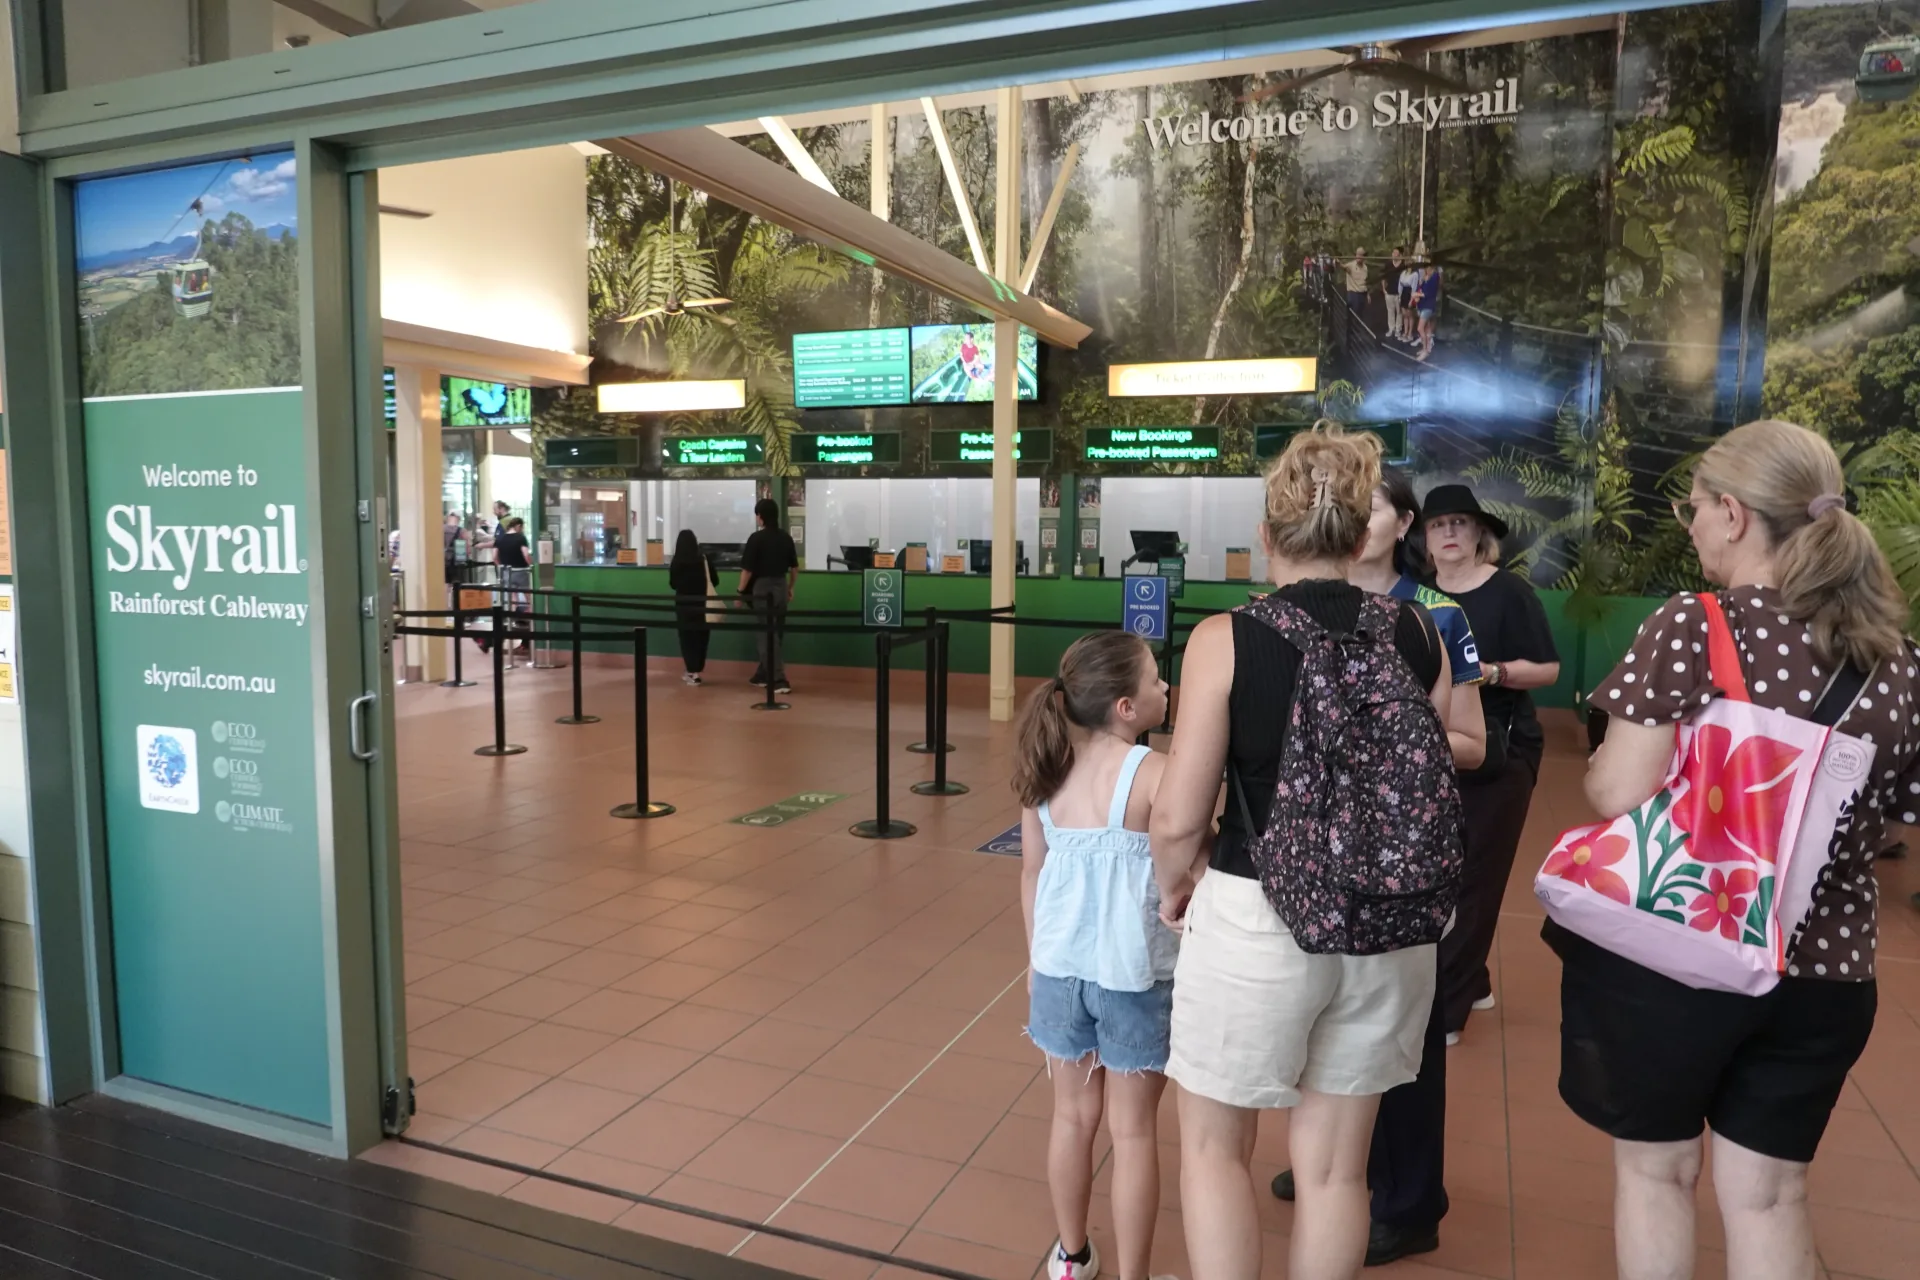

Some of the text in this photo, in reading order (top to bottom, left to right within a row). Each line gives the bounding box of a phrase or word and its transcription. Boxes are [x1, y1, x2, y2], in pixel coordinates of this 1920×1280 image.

[1142, 108, 1309, 150] Welcome
[1321, 99, 1360, 133] to
[1438, 114, 1518, 129] Rainforest Cableway
[816, 436, 873, 447] Pre-booked
[960, 432, 1022, 444] Pre-bod
[1111, 429, 1193, 443] New Bookings
[679, 439, 747, 451] Coach Captains
[1087, 446, 1218, 459] Pre-booked Passengers
[680, 452, 746, 463] & Tour Leaders
[817, 451, 873, 463] Passengers
[142, 463, 258, 488] Welcome to
[109, 590, 309, 627] Rainforest Cableway
[144, 663, 276, 695] skyrail.com.au
[228, 723, 256, 739] ECO
[229, 758, 258, 775] ECO
[231, 803, 285, 823] CLIMATE
